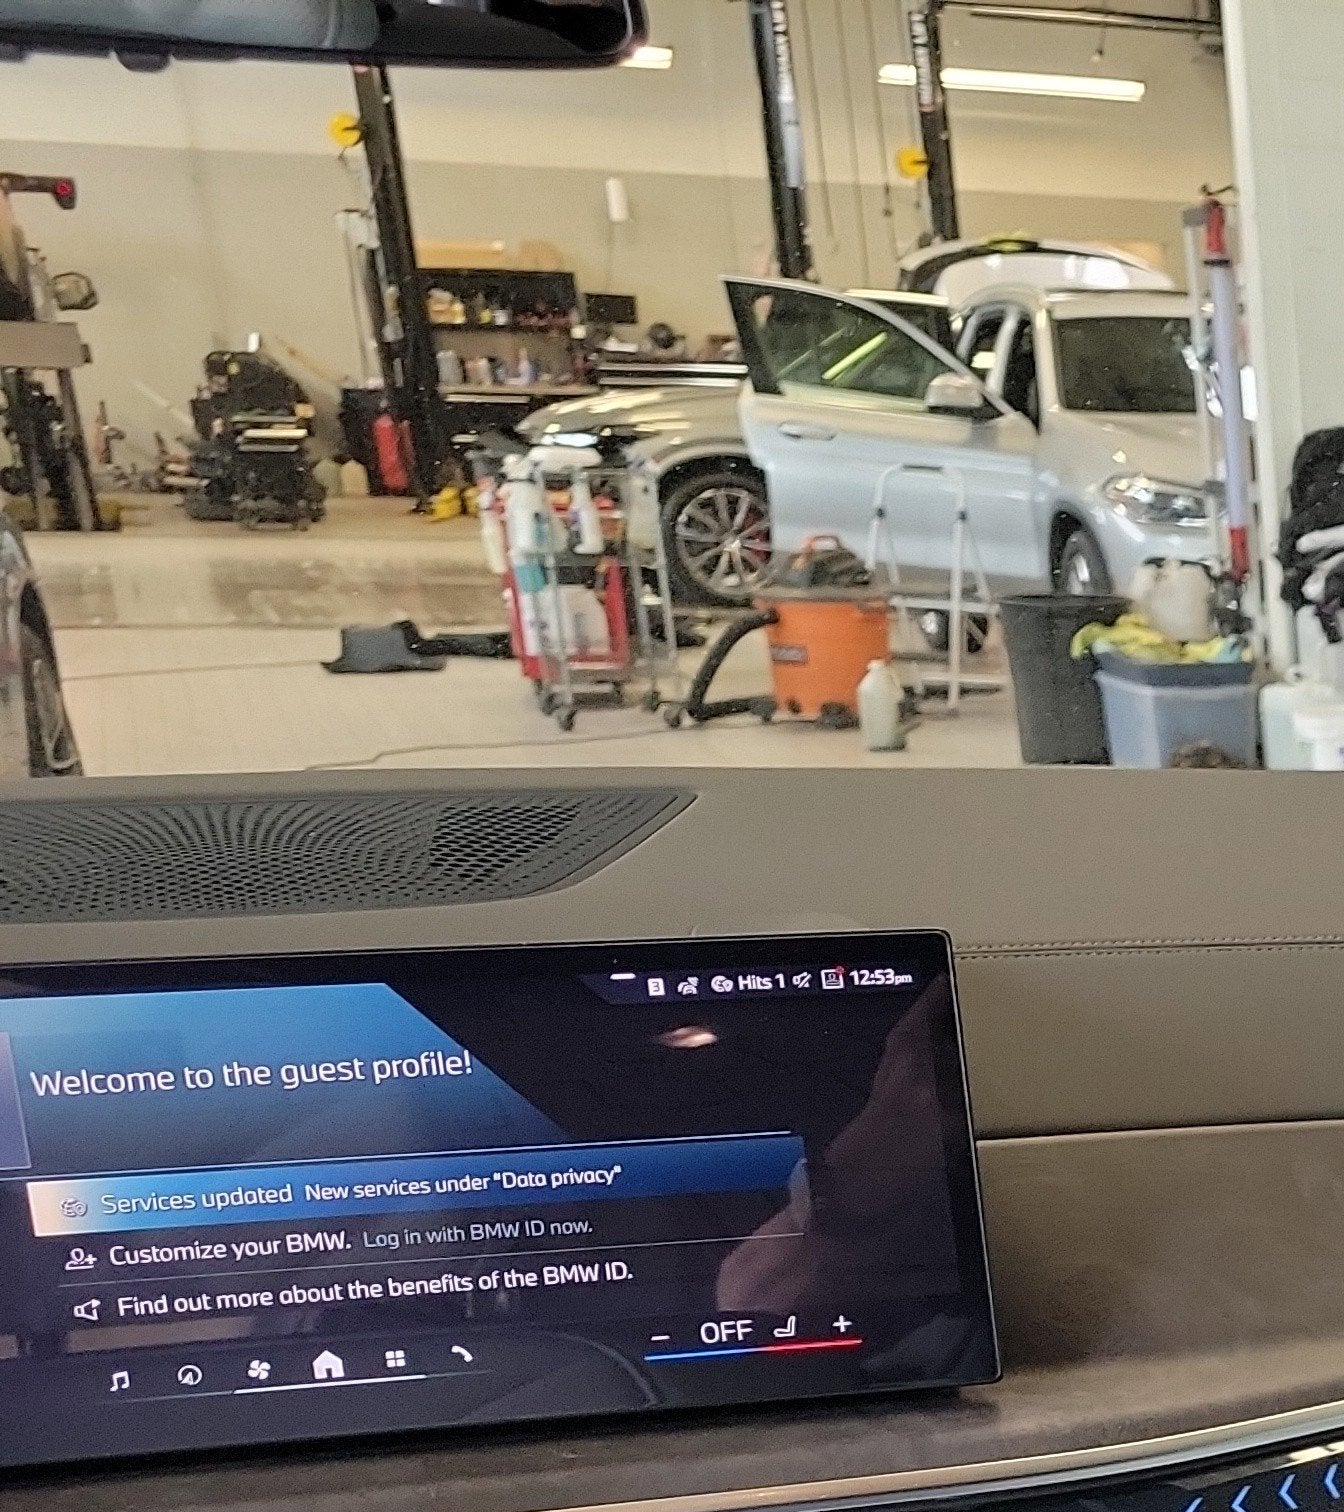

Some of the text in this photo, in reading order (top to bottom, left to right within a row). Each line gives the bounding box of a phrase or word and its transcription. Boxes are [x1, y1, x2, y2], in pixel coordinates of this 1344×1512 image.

[738, 968, 913, 990] Hits 1 12:53pm
[30, 1050, 473, 1097] Welcome to the guest profile!
[100, 1165, 622, 1214] Services updated New services under "Data privacy"
[109, 1220, 593, 1266] Customize your BMW. Log in with BMW ID now.
[117, 1262, 634, 1317] Find out more about the benefits of the BMW ID.
[700, 1320, 753, 1344] OFF
